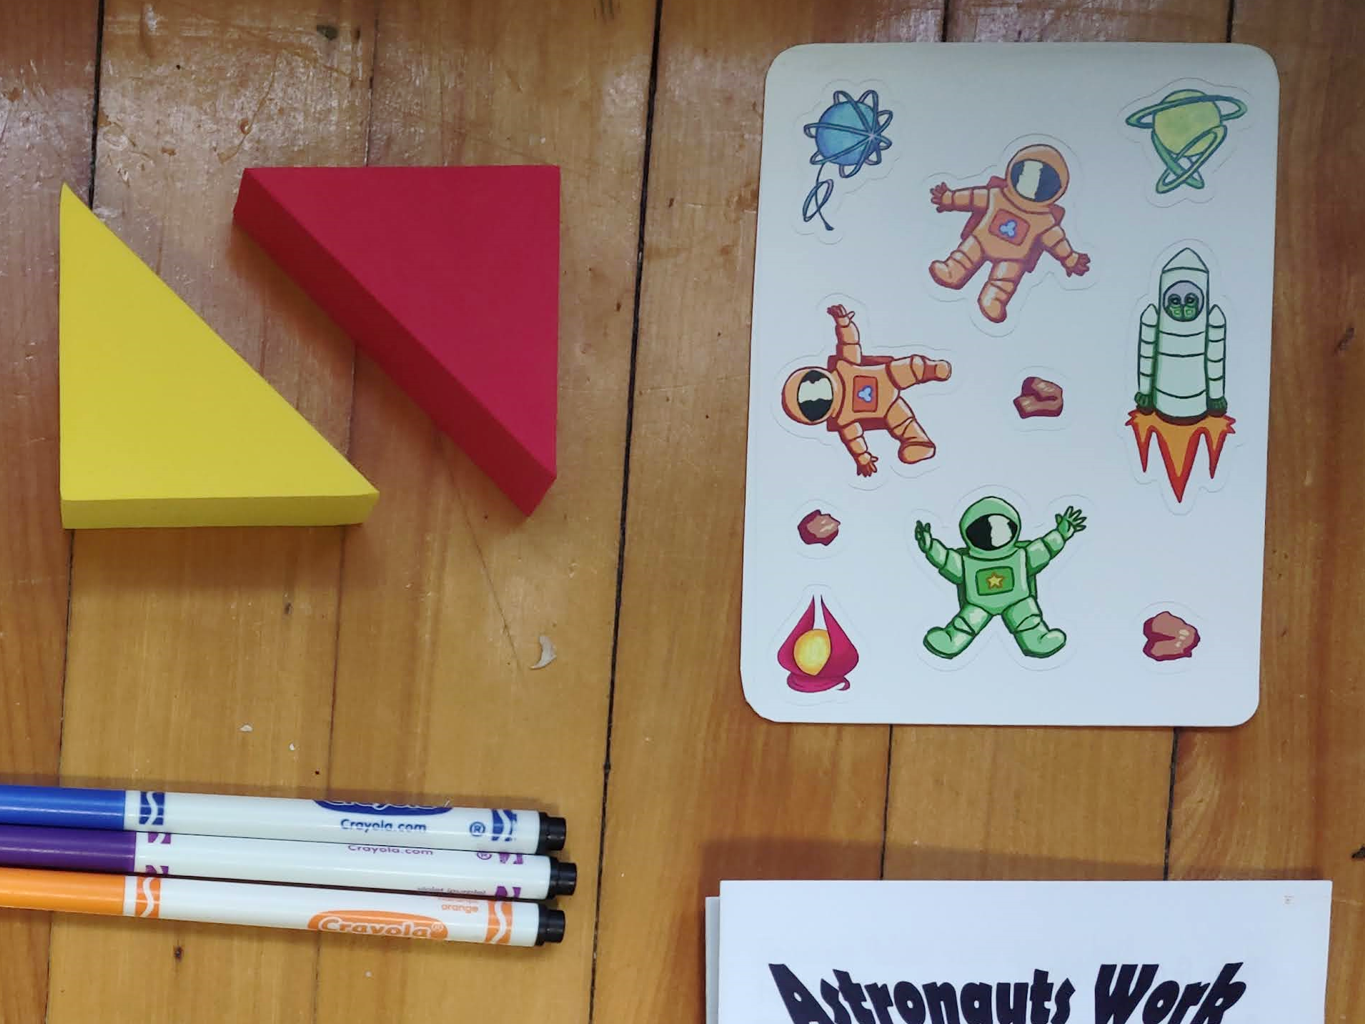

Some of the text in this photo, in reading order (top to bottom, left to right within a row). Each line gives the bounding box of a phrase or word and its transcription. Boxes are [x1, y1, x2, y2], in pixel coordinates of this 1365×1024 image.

[340, 819, 428, 833] Crayola.com
[347, 844, 434, 856] Crayola.com
[441, 903, 480, 914] orange
